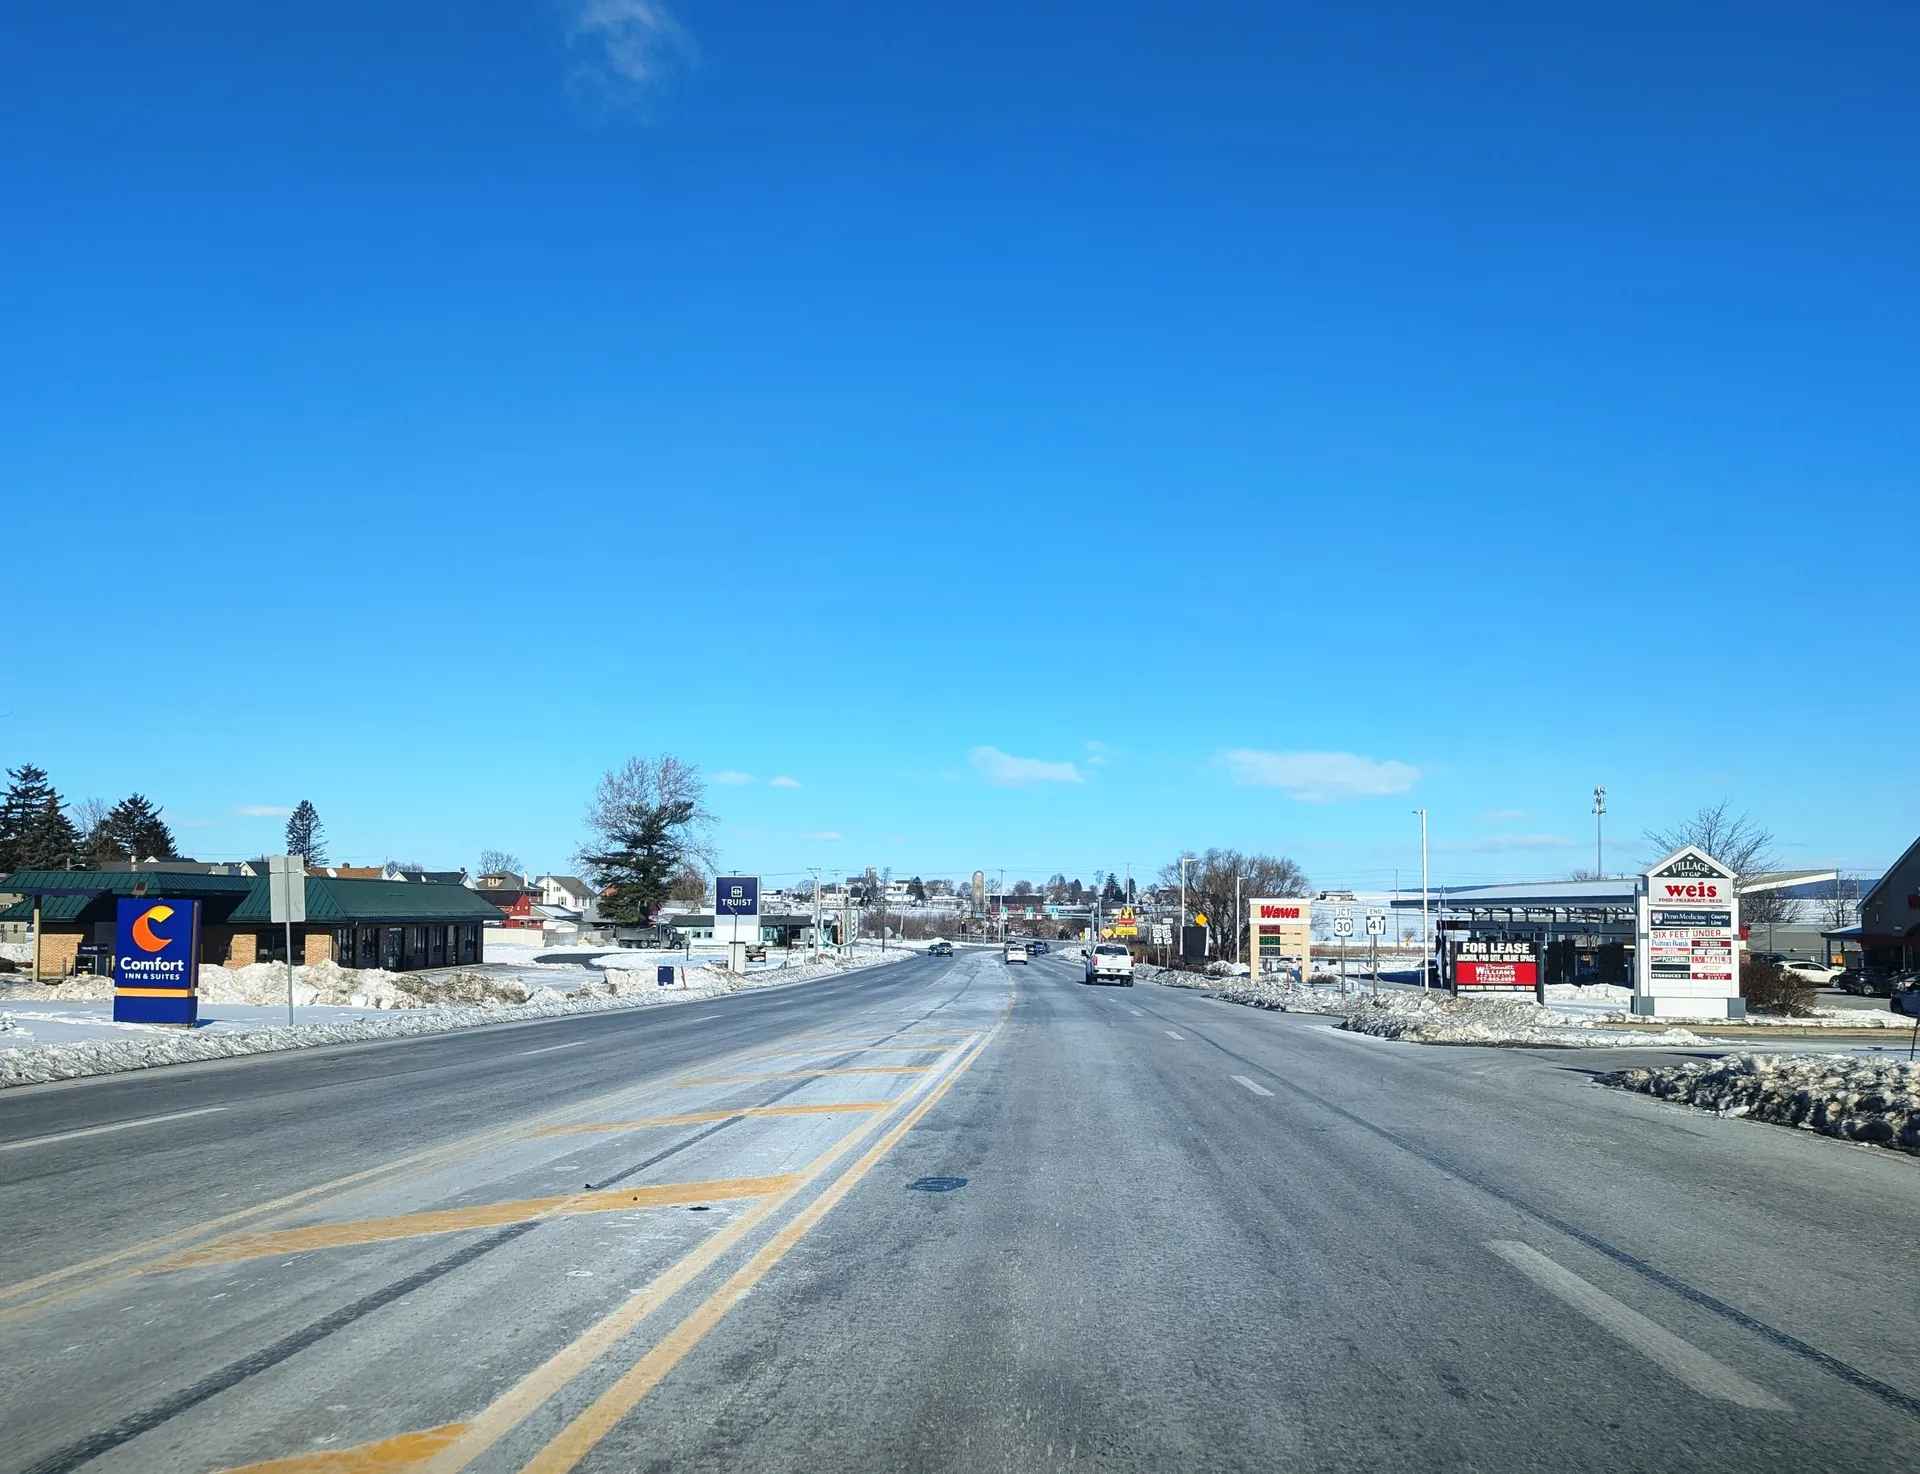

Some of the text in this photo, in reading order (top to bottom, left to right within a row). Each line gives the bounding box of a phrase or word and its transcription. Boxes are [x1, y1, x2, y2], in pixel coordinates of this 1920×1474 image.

[1671, 861, 1710, 874] VILLAGE
[1665, 881, 1717, 898] weis
[1260, 905, 1300, 919] Wawa
[1336, 908, 1350, 917] JCT
[1336, 922, 1351, 933] 30
[1368, 920, 1382, 931] 41
[1652, 929, 1721, 939] SIX FEET UNDER
[1462, 942, 1530, 954] FOR LEASE
[120, 956, 185, 971] Comfort
[1520, 954, 1536, 962] SPACE
[1475, 966, 1516, 975] WILLIAMS
